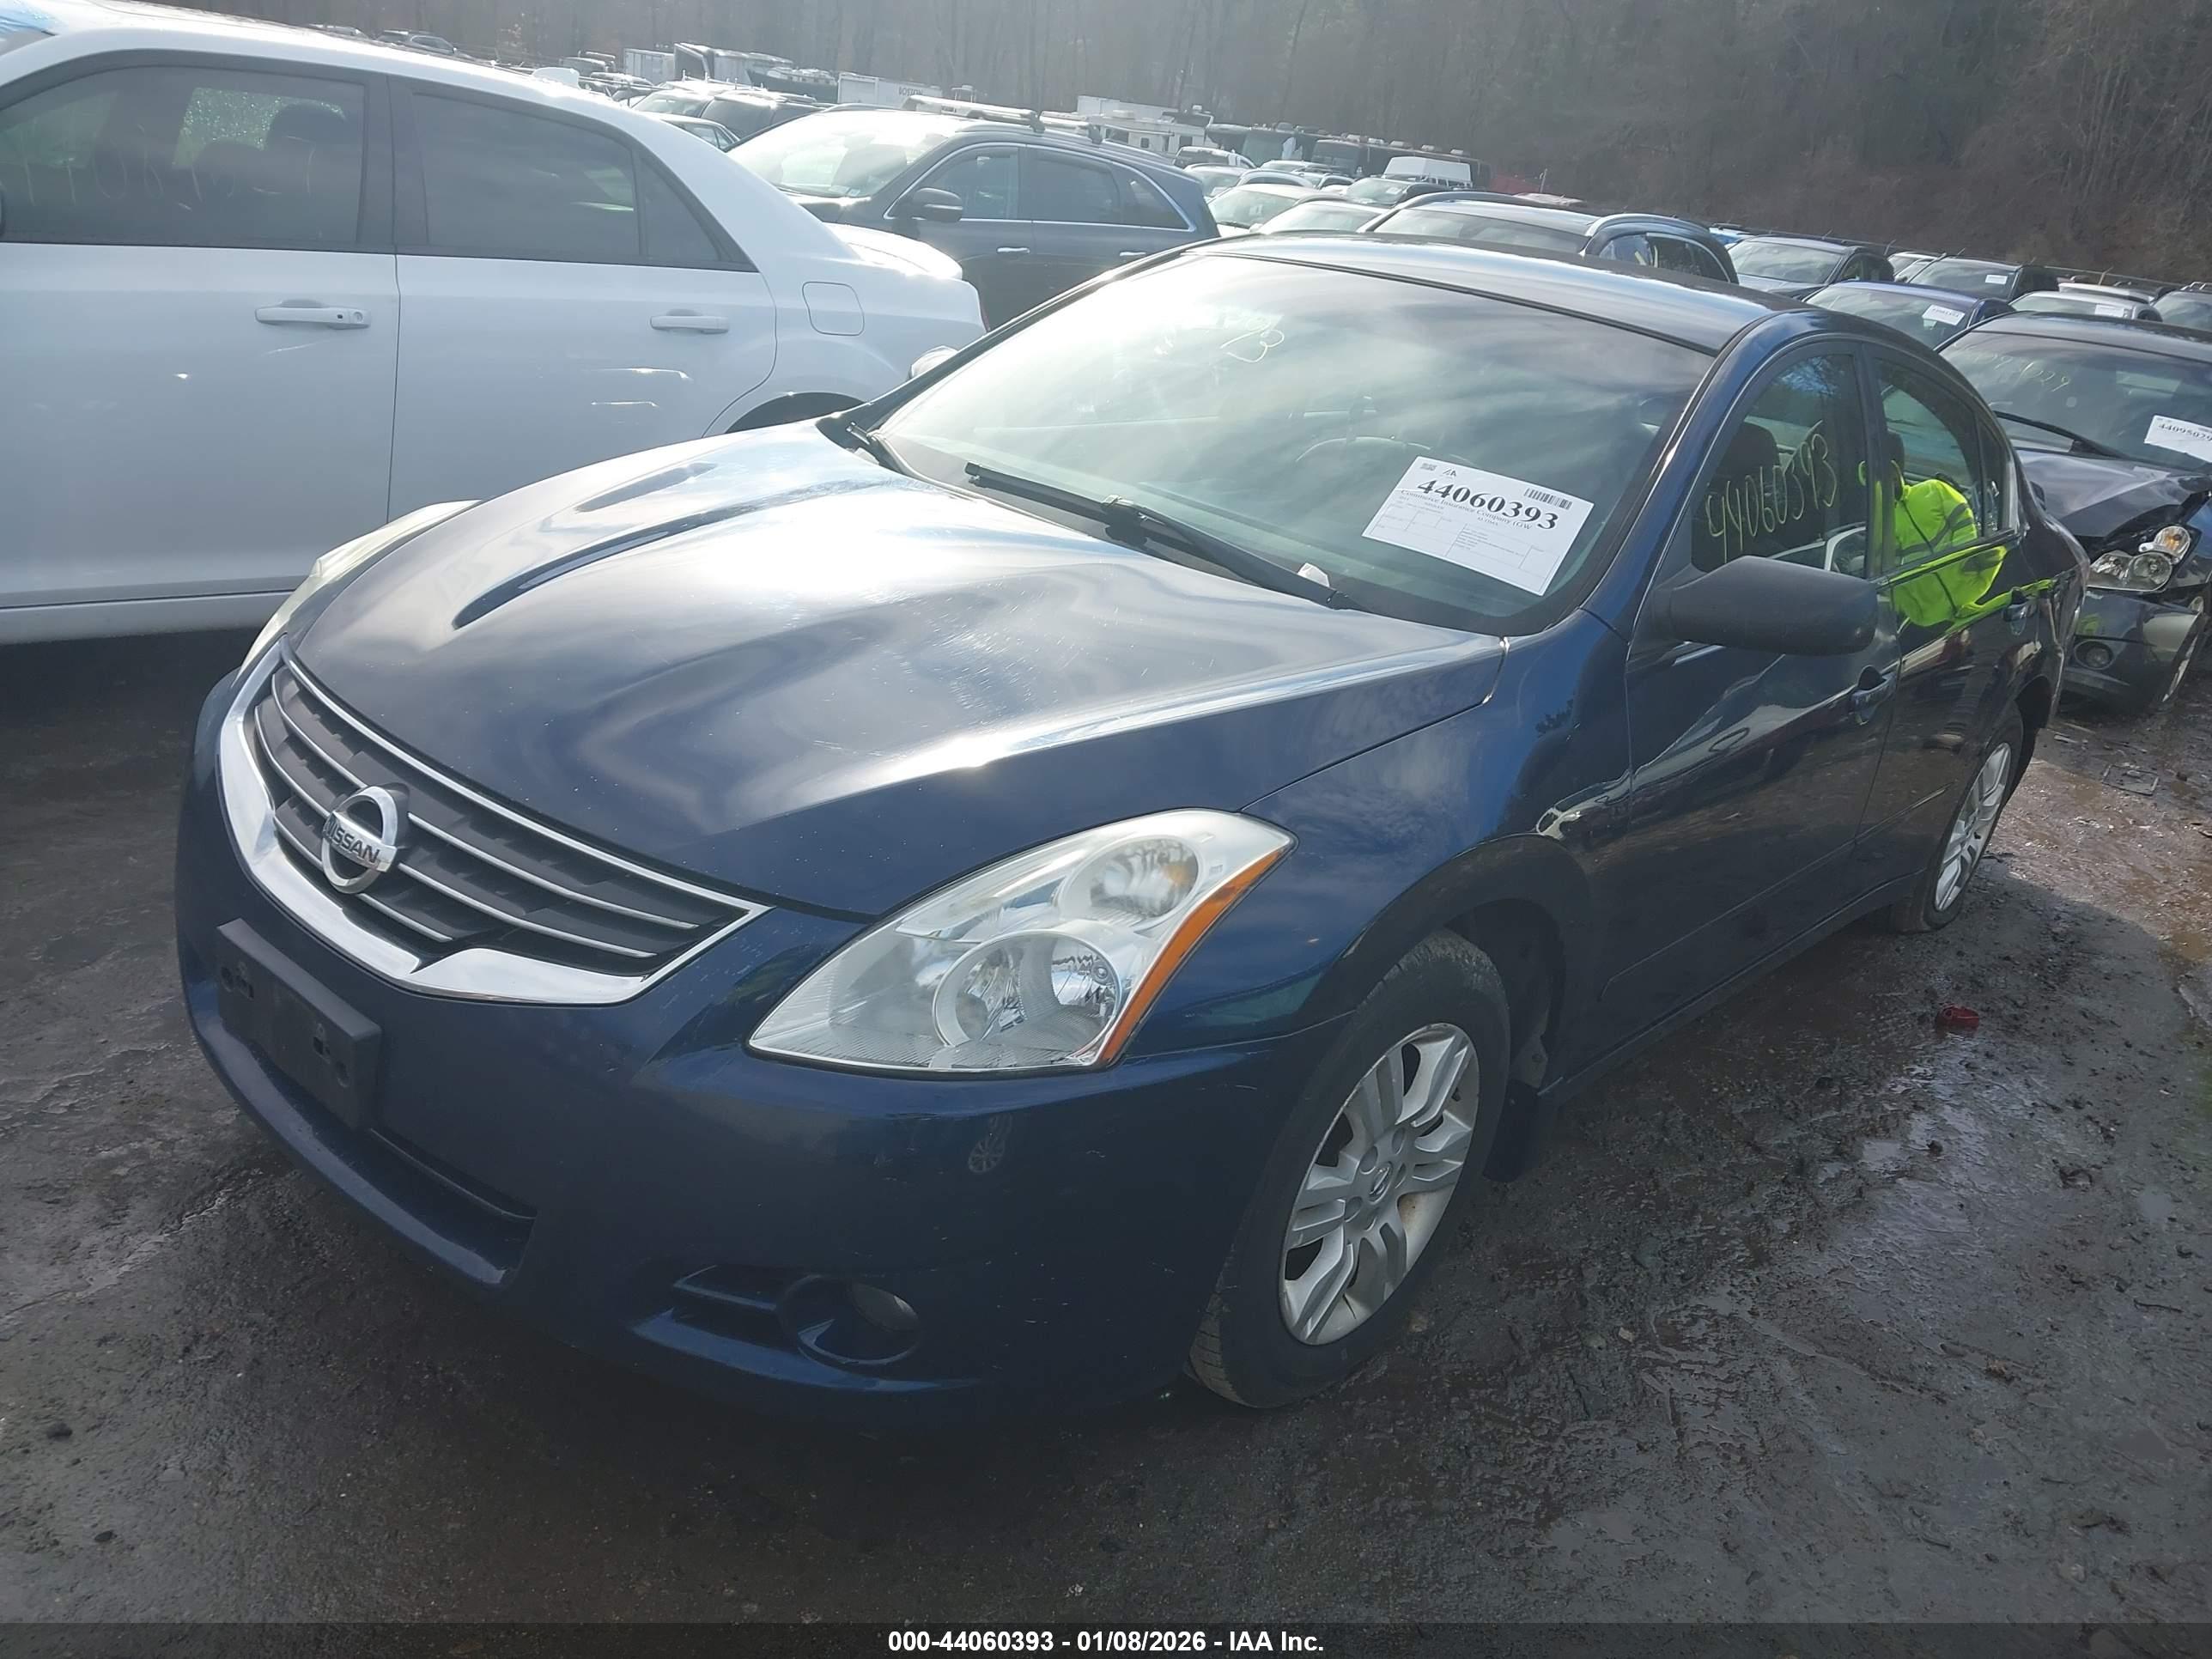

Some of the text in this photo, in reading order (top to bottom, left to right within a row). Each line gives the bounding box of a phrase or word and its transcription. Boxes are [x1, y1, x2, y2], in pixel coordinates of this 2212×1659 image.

[1417, 479, 1559, 530] 44060393
[1705, 419, 1838, 564] 44060393
[322, 817, 380, 863] NISSAN
